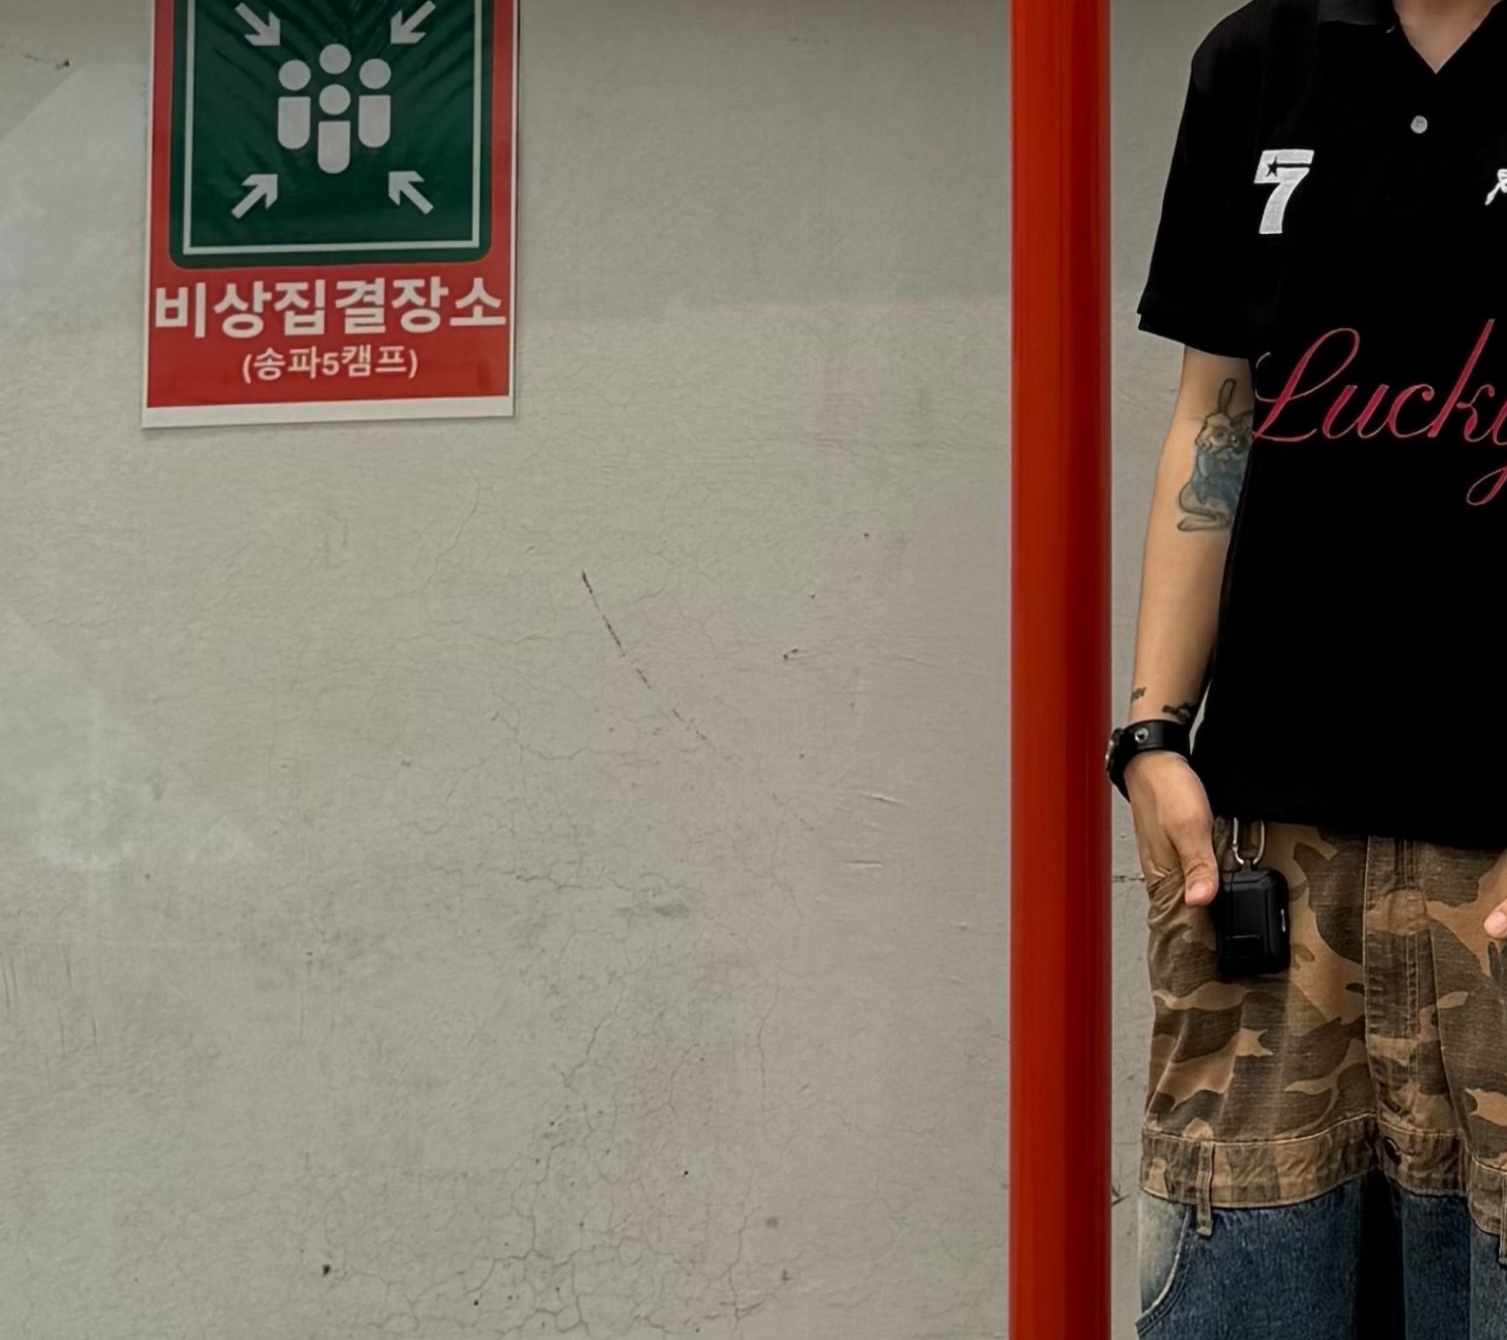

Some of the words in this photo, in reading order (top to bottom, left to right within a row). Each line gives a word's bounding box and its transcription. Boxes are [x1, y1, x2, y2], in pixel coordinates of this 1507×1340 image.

[1254, 149, 1314, 234] 7
[155, 276, 507, 339] 비상집결장소
[242, 344, 418, 384] (송파5캠프)
